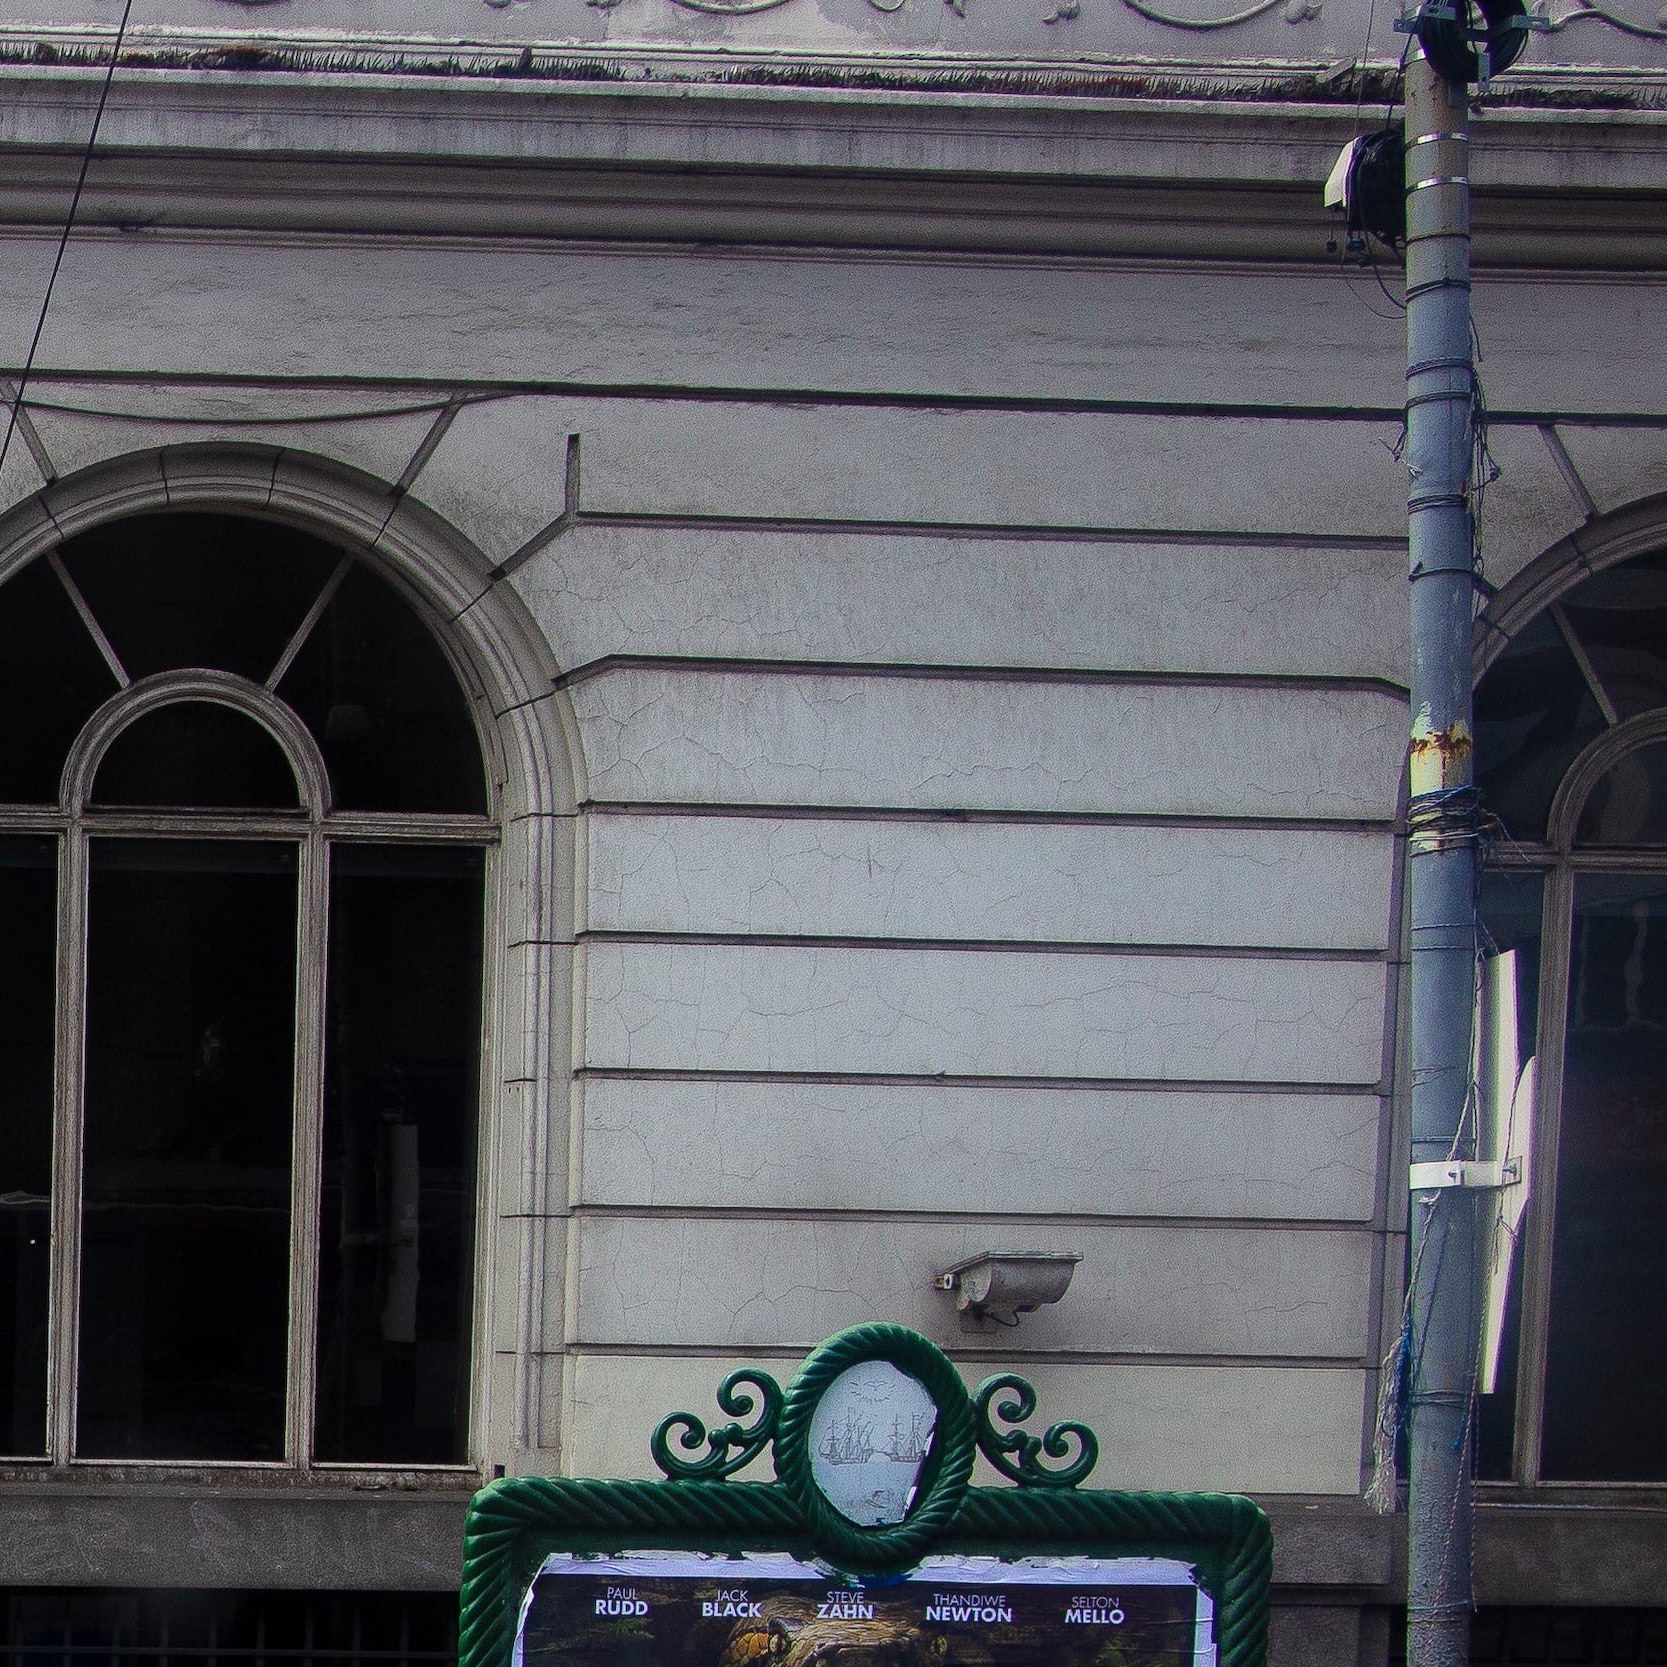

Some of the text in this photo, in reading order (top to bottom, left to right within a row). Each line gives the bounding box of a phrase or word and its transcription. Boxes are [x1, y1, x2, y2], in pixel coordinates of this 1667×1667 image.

[607, 1586, 638, 1600] PAUL
[717, 1588, 749, 1602] JACK
[826, 1591, 865, 1605] STEVE
[933, 1593, 1007, 1607] THANDIWE
[595, 1600, 649, 1616] RUDD
[702, 1602, 762, 1618] BLACK
[1071, 1596, 1120, 1609] SELTON
[816, 1604, 874, 1620] ZAHN
[925, 1606, 1013, 1623] NEWTON
[1064, 1609, 1125, 1625] MELLO
